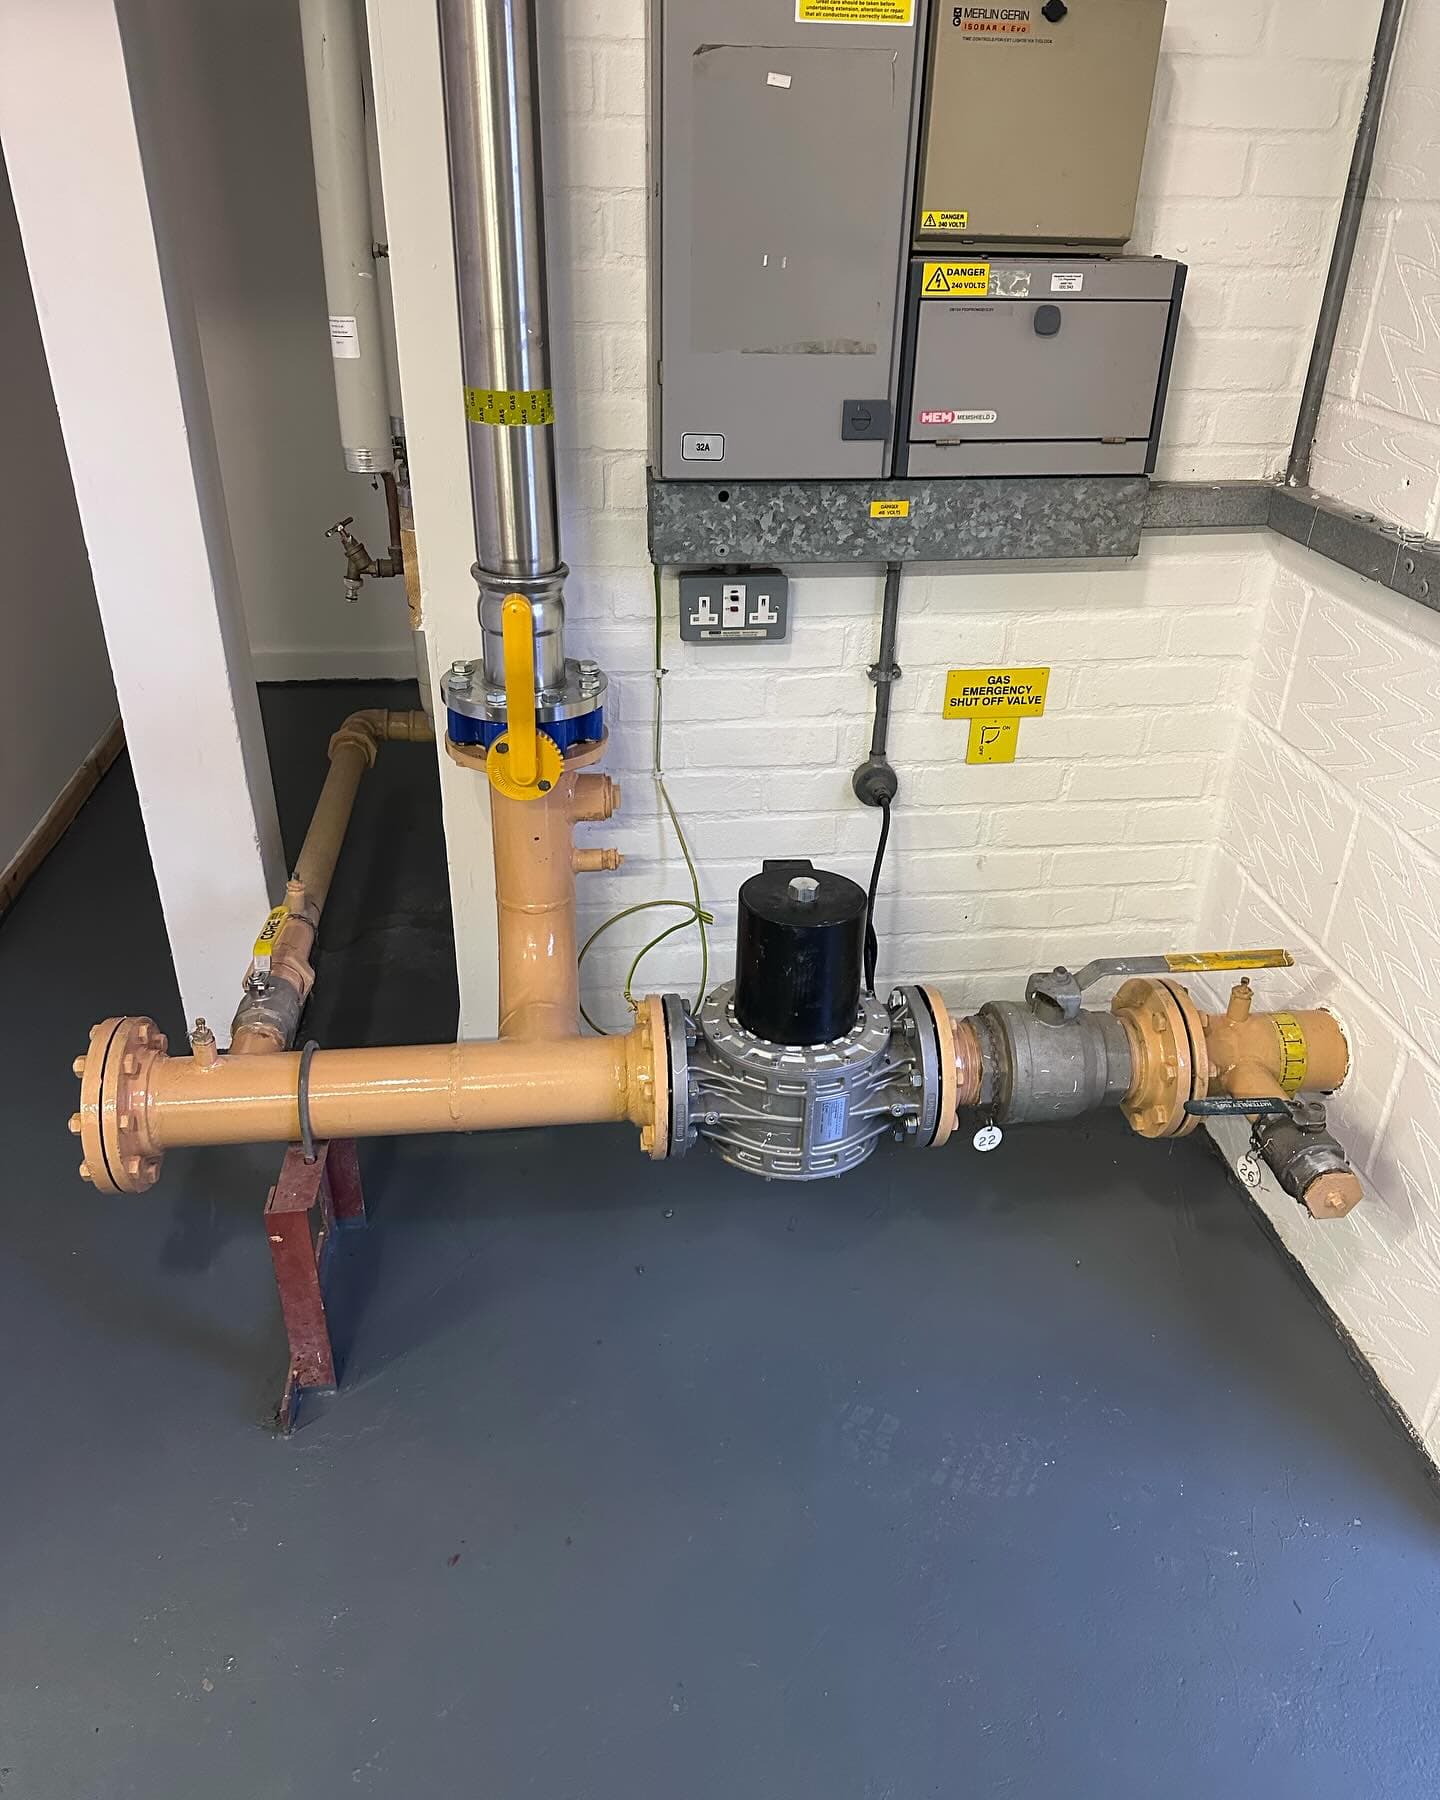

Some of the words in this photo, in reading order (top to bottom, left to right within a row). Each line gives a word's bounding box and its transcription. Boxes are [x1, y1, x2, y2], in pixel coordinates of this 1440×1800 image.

[963, 8, 1000, 20] MERLIN
[1000, 9, 1030, 21] GERIN
[964, 23, 997, 31] ISOBAR
[946, 268, 986, 277] DANGER
[498, 408, 506, 424] GAS
[921, 412, 953, 423] MEM
[695, 443, 710, 452] 32A
[987, 675, 1011, 685] GAS
[962, 685, 1033, 696] EMERGENCY
[950, 697, 980, 707] SHUT
[982, 696, 1004, 706] OFF
[1007, 695, 1042, 705] VALVE
[978, 1134, 996, 1147] 22
[1239, 1163, 1255, 1183] 26
